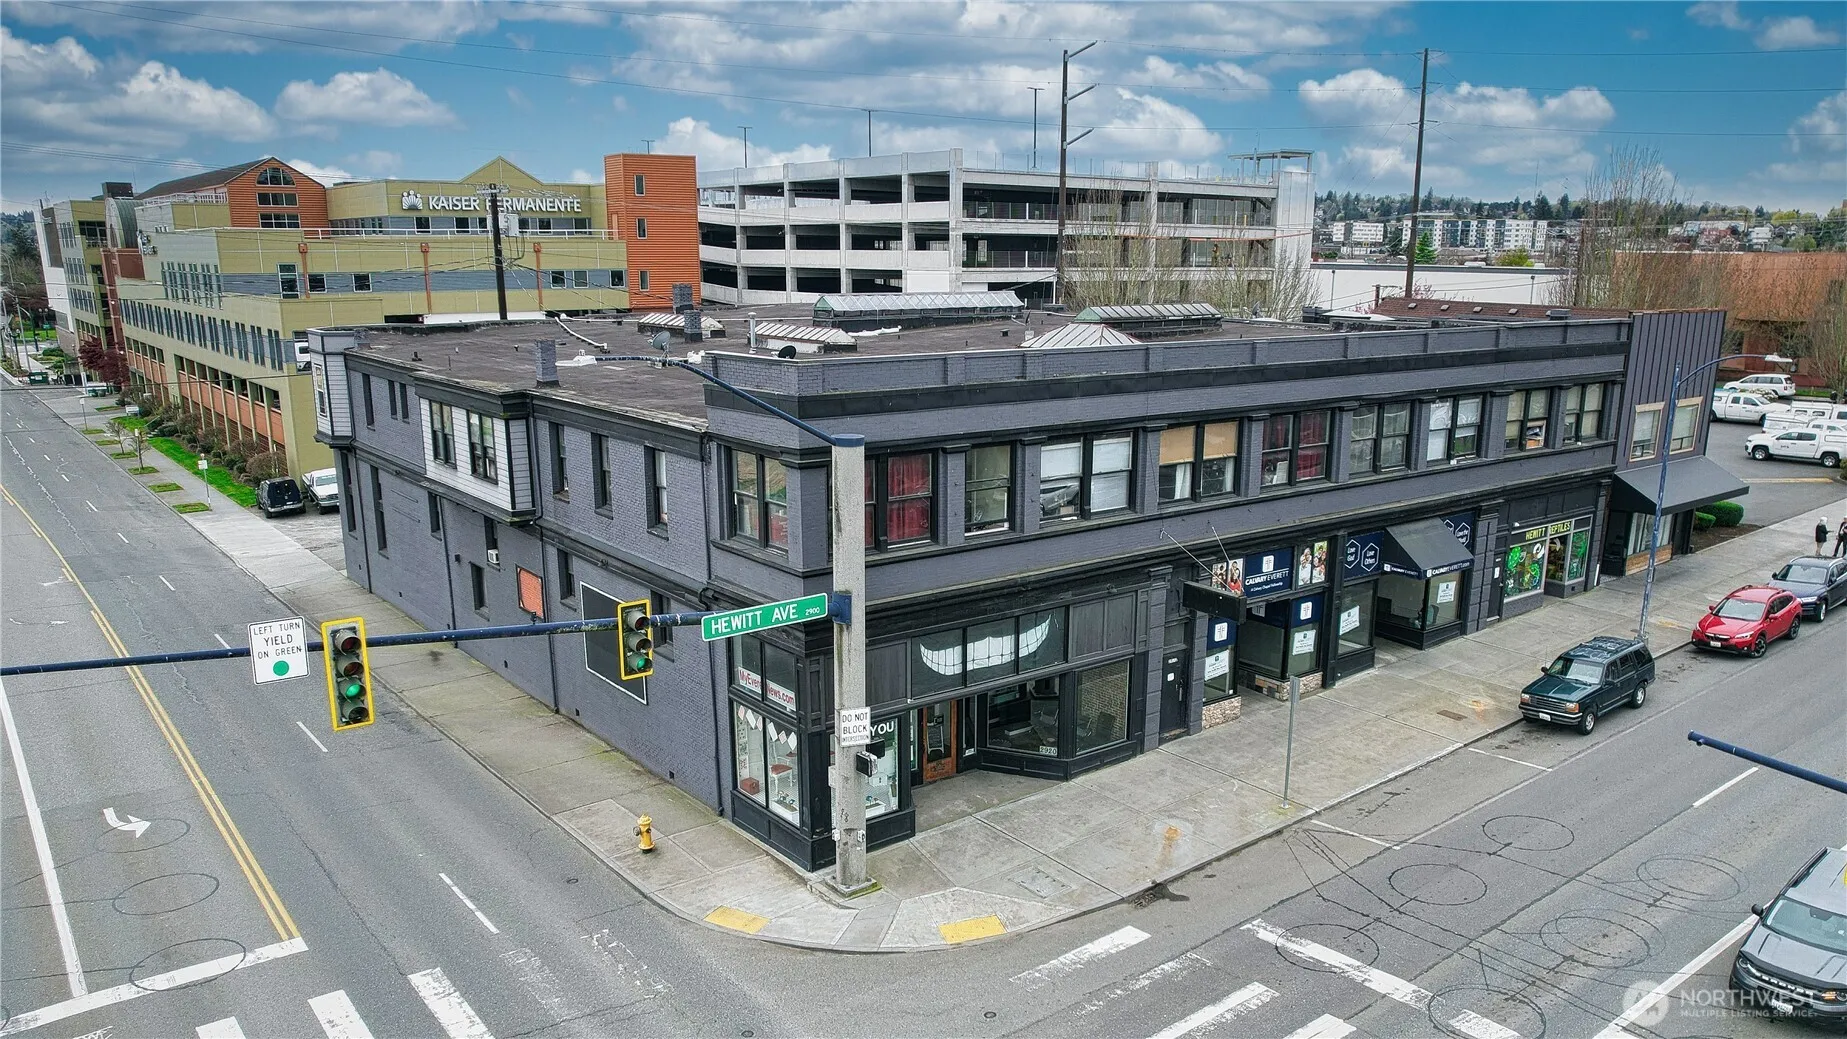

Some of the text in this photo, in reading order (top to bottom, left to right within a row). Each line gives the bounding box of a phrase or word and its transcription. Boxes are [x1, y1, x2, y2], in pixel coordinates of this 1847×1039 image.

[429, 196, 582, 212] KAISER PERMANENTE
[1525, 527, 1545, 540] HEWITT
[1245, 570, 1289, 586] CALVARY EVERETT
[711, 604, 820, 634] HEWITT AVE 2900
[253, 622, 301, 636] LEFT TURN
[264, 634, 293, 647] YIELD
[257, 646, 302, 660] ON GREEN
[842, 712, 868, 723] DO NOT
[843, 724, 868, 735] BLOCK
[870, 721, 894, 737] YOU
